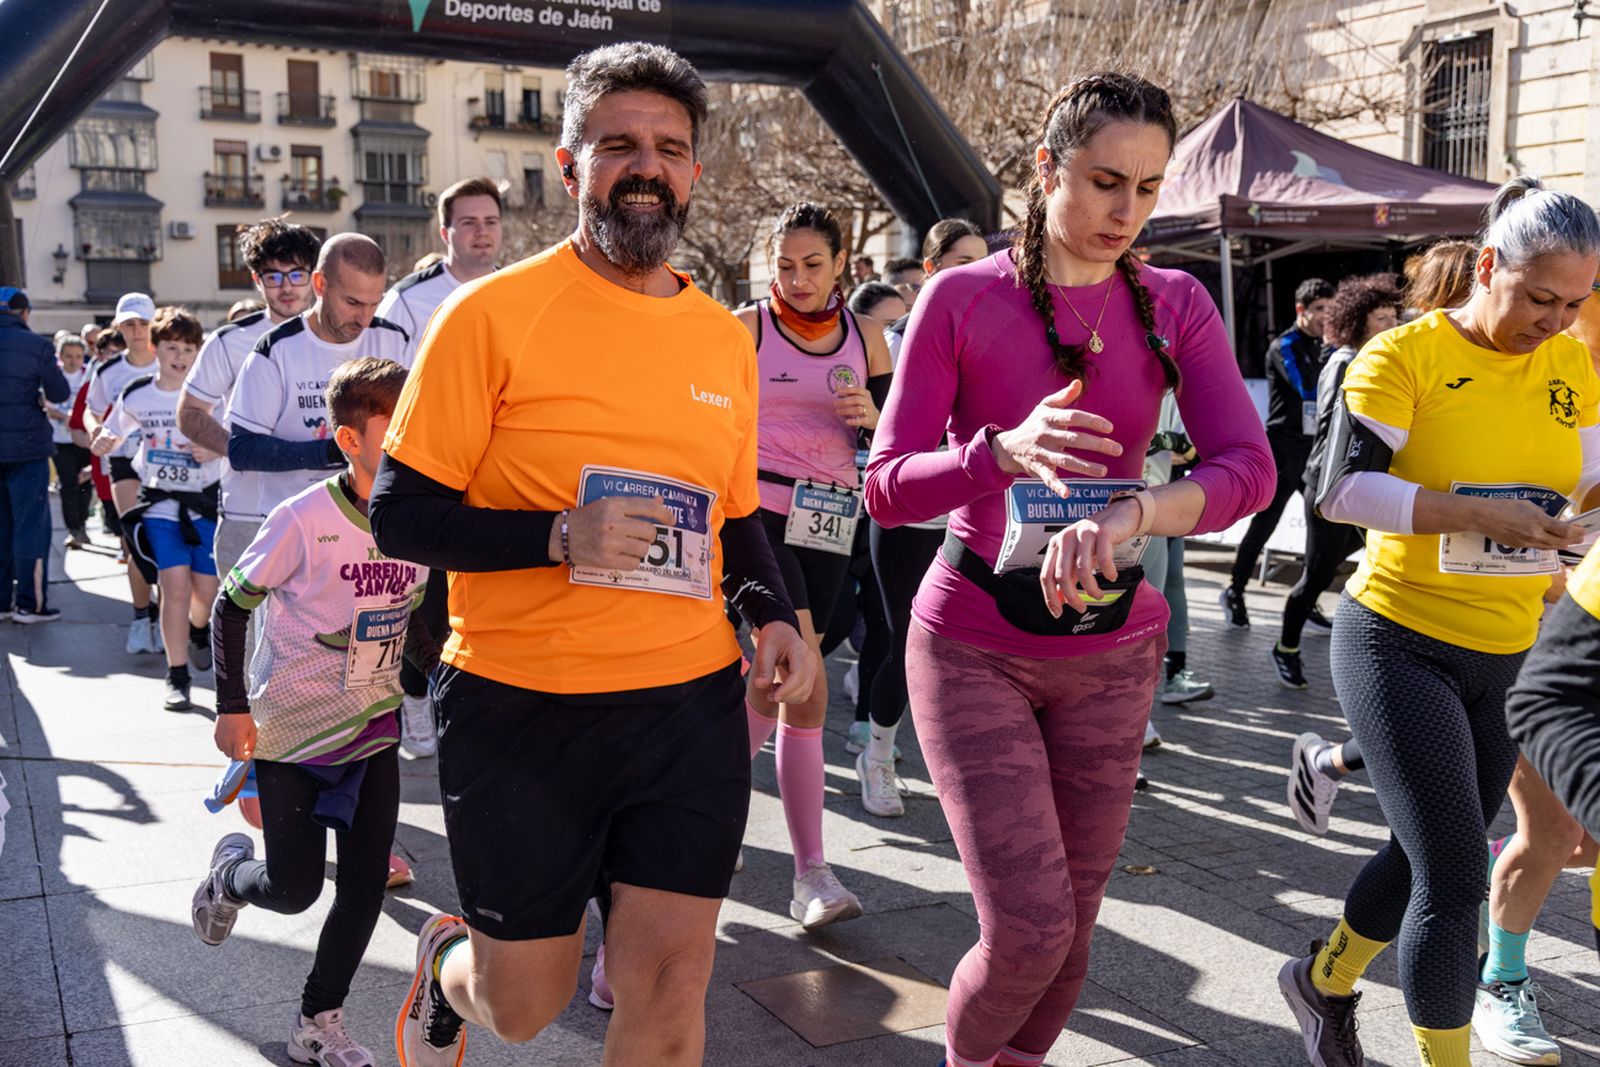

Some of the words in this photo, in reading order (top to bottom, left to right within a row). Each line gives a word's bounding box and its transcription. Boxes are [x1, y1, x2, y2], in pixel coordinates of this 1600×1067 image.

[546, 0, 633, 12] cipal
[637, 0, 661, 13] de
[444, 0, 534, 23] Deportes
[538, 6, 564, 26] de
[567, 9, 613, 31] Jaén
[298, 395, 326, 409] BUEN
[157, 465, 189, 482] 638
[603, 480, 614, 490] VI
[616, 481, 660, 498] CARRERA
[661, 490, 698, 508] CAMINATA
[1026, 489, 1036, 498] VI
[1037, 488, 1082, 498] CARRA
[1082, 488, 1117, 498] CAMIN
[1027, 503, 1064, 519] BUENA
[1068, 502, 1108, 519] MUERT
[808, 512, 842, 538] 341
[641, 527, 682, 568] 51
